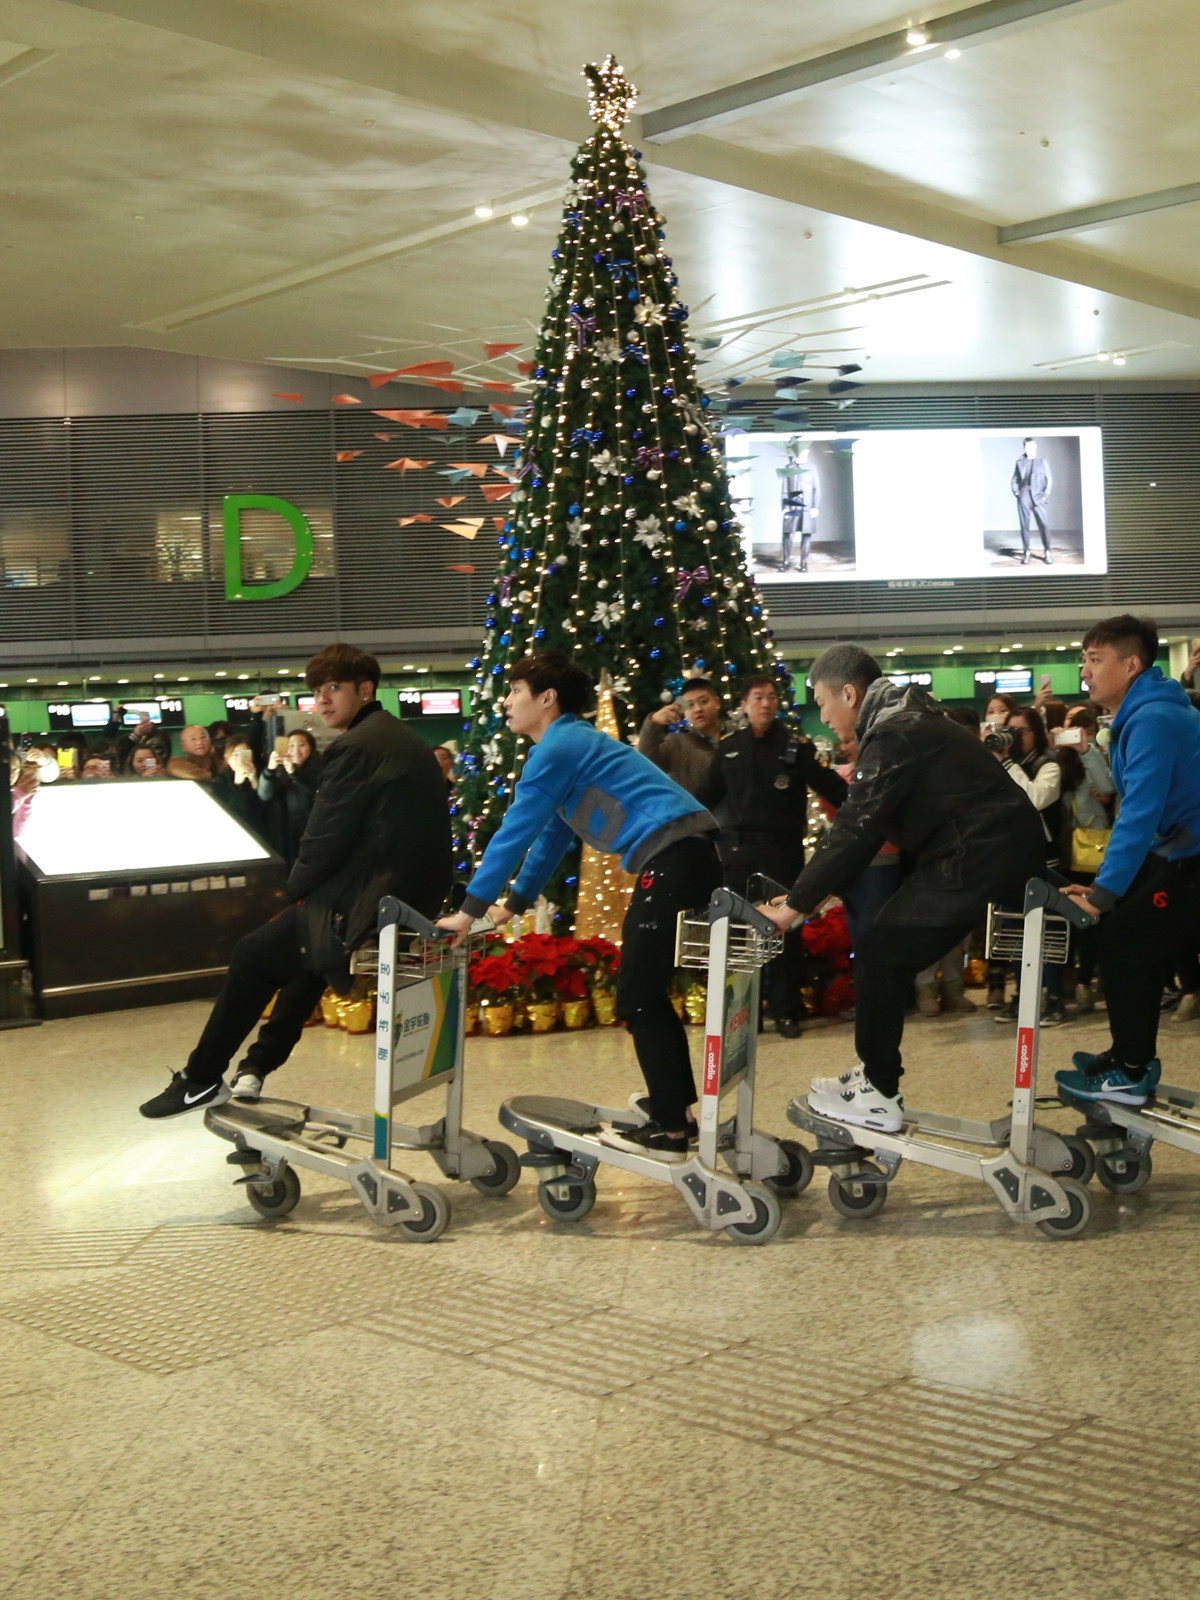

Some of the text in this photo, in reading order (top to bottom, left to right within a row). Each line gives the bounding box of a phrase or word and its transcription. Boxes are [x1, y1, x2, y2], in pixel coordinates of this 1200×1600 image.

[223, 495, 314, 601] D
[378, 962, 391, 1061] 金宇轮胎
